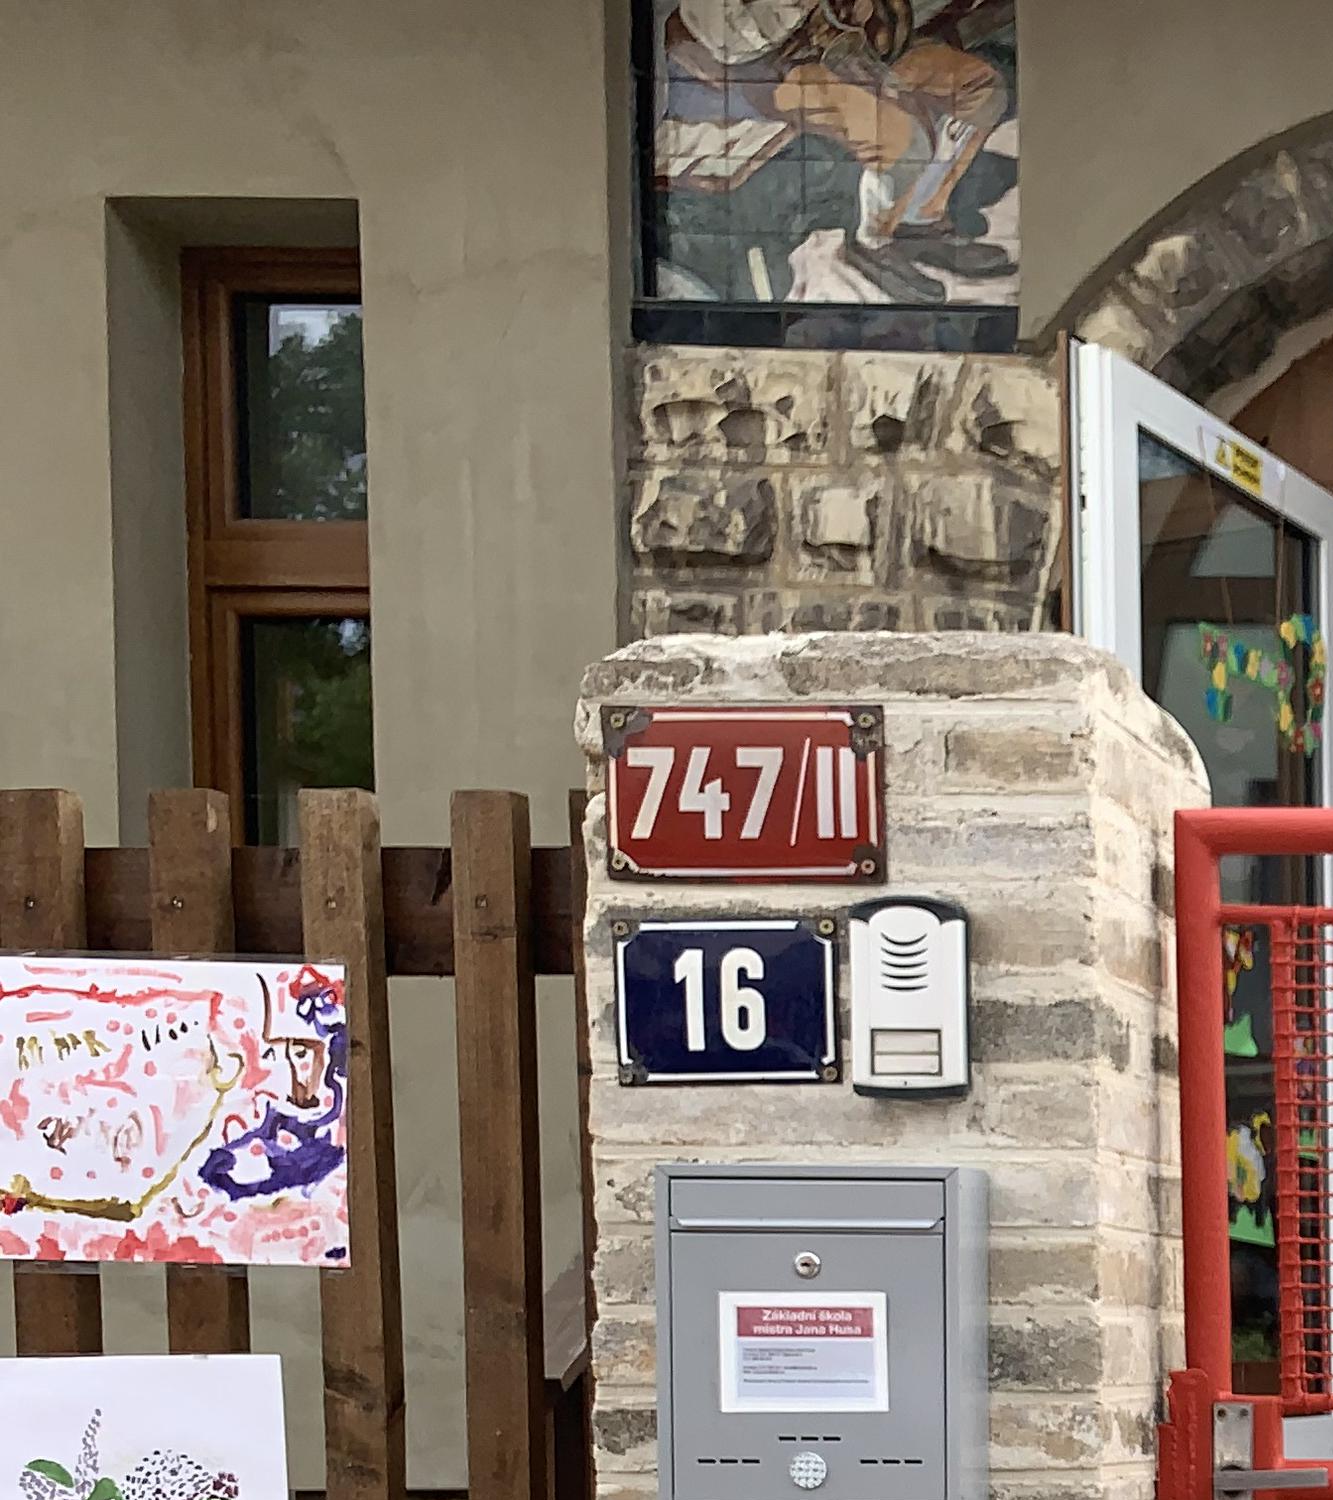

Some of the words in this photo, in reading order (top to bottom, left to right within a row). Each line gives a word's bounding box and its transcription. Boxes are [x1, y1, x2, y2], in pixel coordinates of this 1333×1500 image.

[627, 737, 858, 846] 747/II
[674, 947, 766, 1052] 16
[753, 1324, 792, 1335] mistra
[795, 1325, 826, 1335] Jana
[829, 1325, 861, 1335] Husa
[761, 1309, 816, 1321] Základní
[819, 1309, 852, 1321] škola
